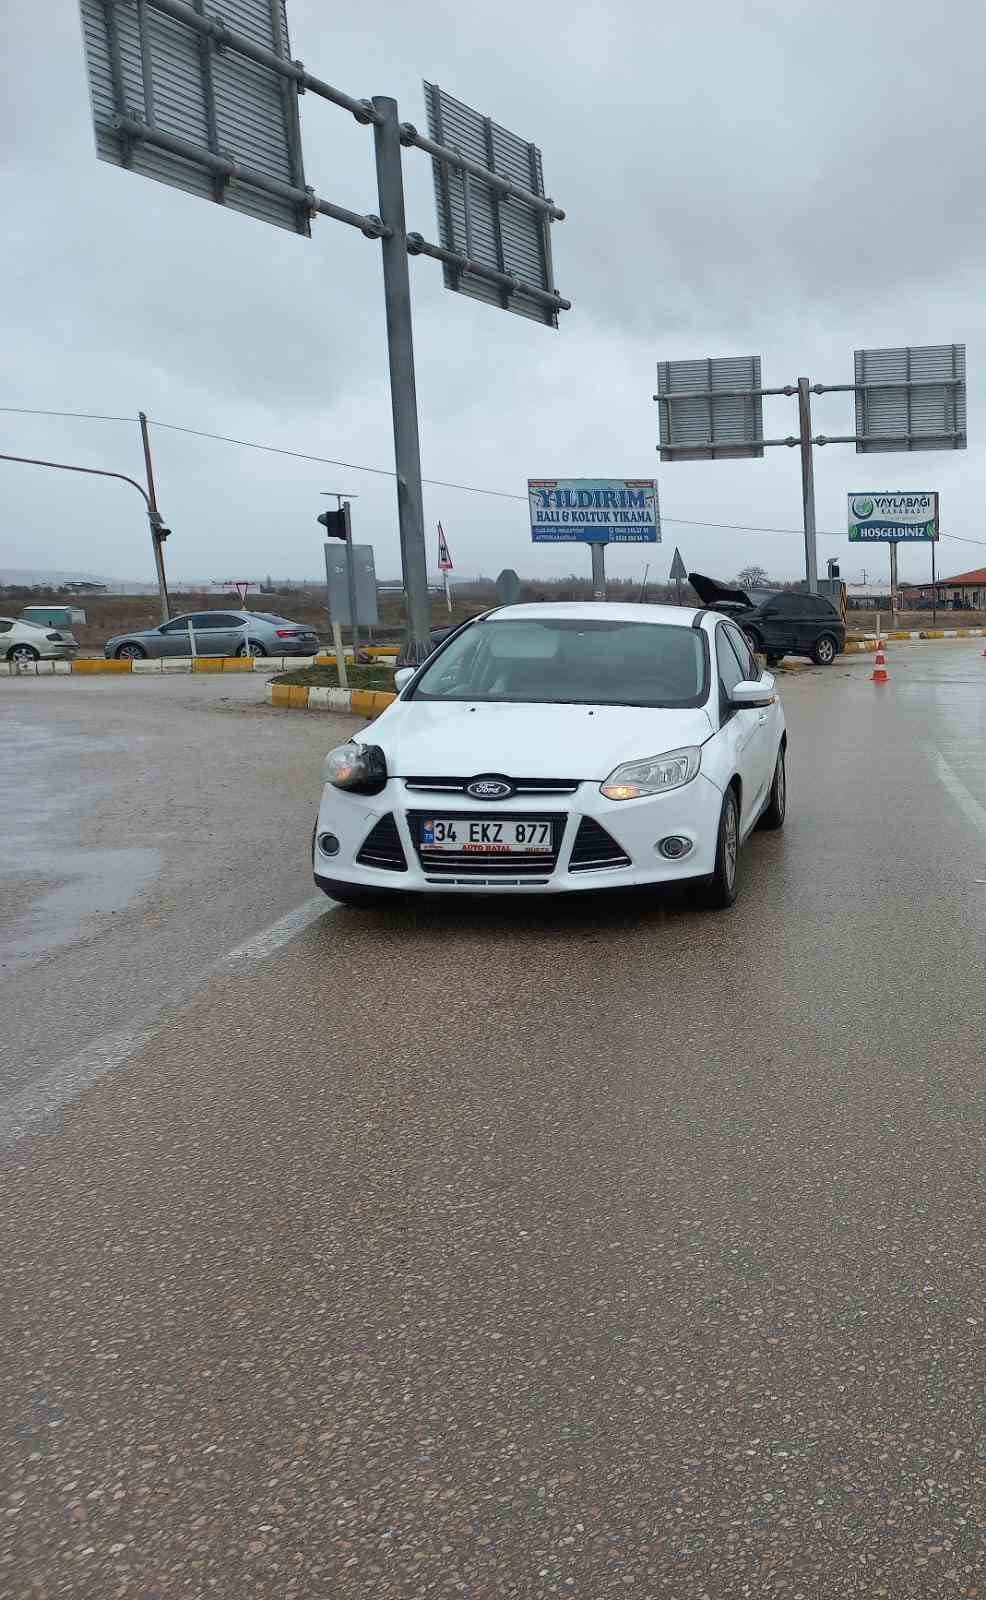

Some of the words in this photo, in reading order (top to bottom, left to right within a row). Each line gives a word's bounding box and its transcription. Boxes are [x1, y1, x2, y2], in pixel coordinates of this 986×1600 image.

[540, 489, 646, 508] YILDIRIM
[874, 496, 930, 507] YAYLABAĞI
[536, 510, 560, 522] HALI
[562, 510, 570, 522] &
[571, 510, 611, 522] KOLTUK
[612, 510, 653, 523] YIKAMA
[476, 783, 500, 793] Ford
[424, 832, 434, 840] TR
[435, 822, 457, 842] 34
[469, 823, 503, 843] EKZ
[515, 824, 549, 844] 877
